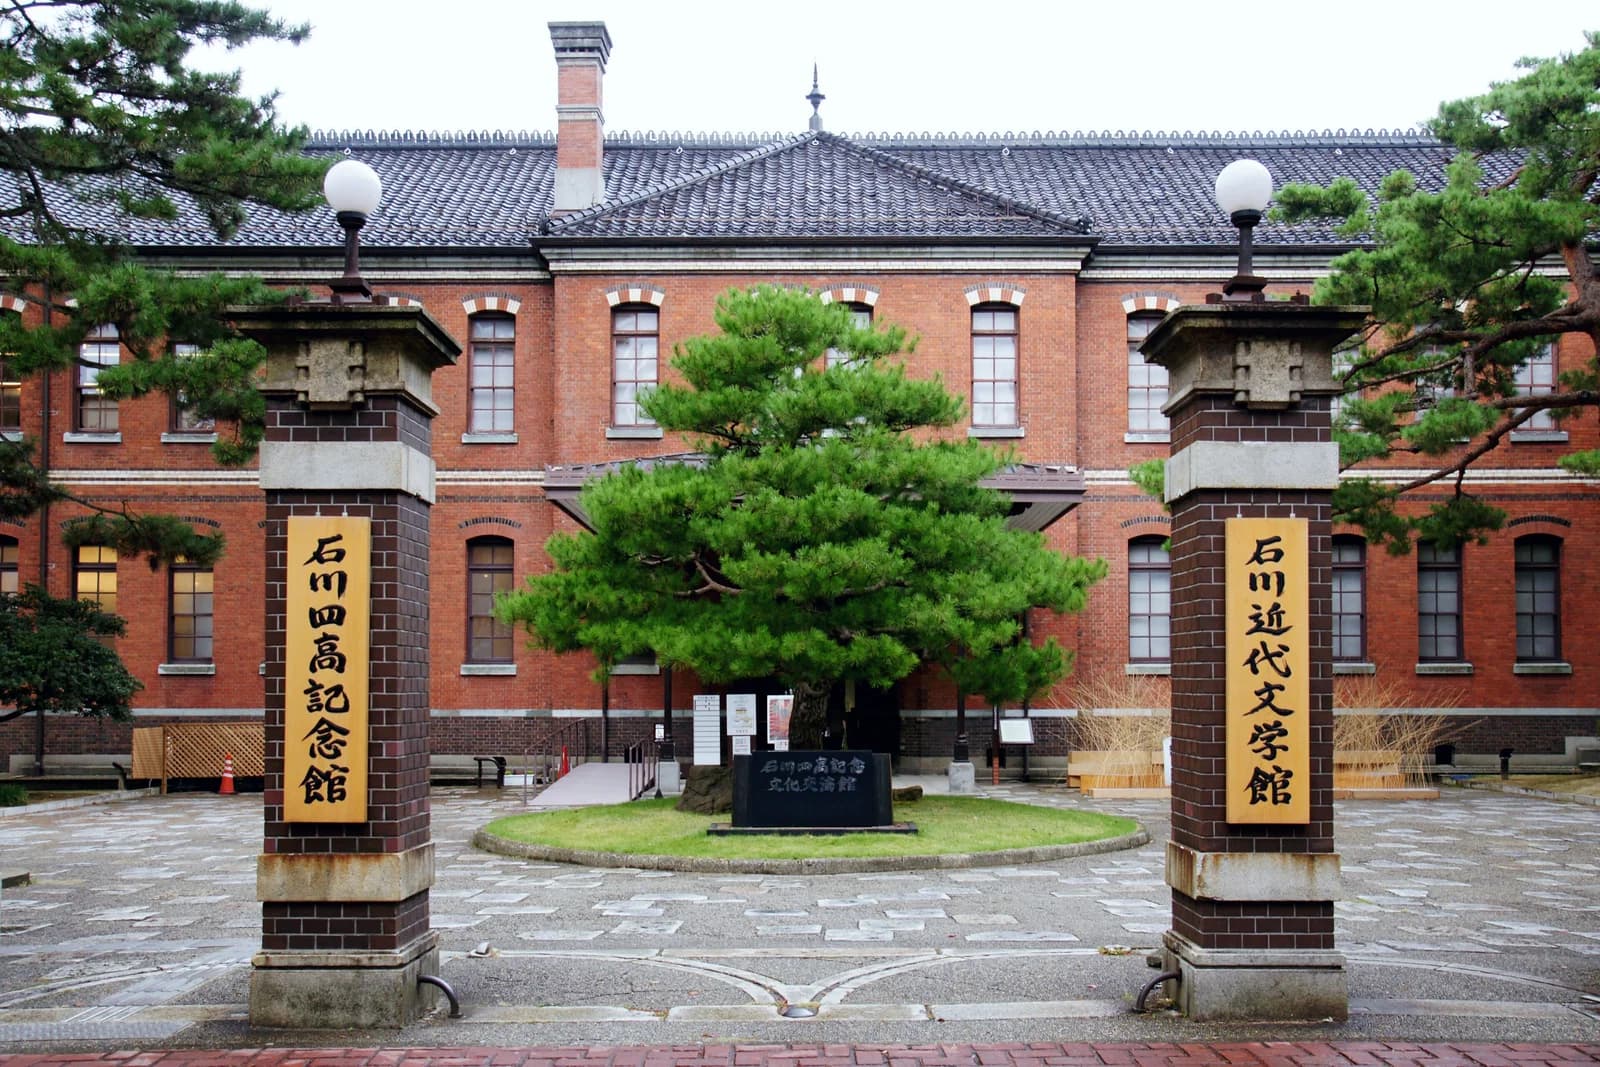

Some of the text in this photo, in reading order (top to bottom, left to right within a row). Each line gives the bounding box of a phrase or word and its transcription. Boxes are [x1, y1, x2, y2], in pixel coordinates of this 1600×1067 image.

[300, 533, 350, 804] 石川四高記念館
[767, 776, 857, 793] 文化交流館
[1242, 535, 1294, 805] 石川近代文学館
